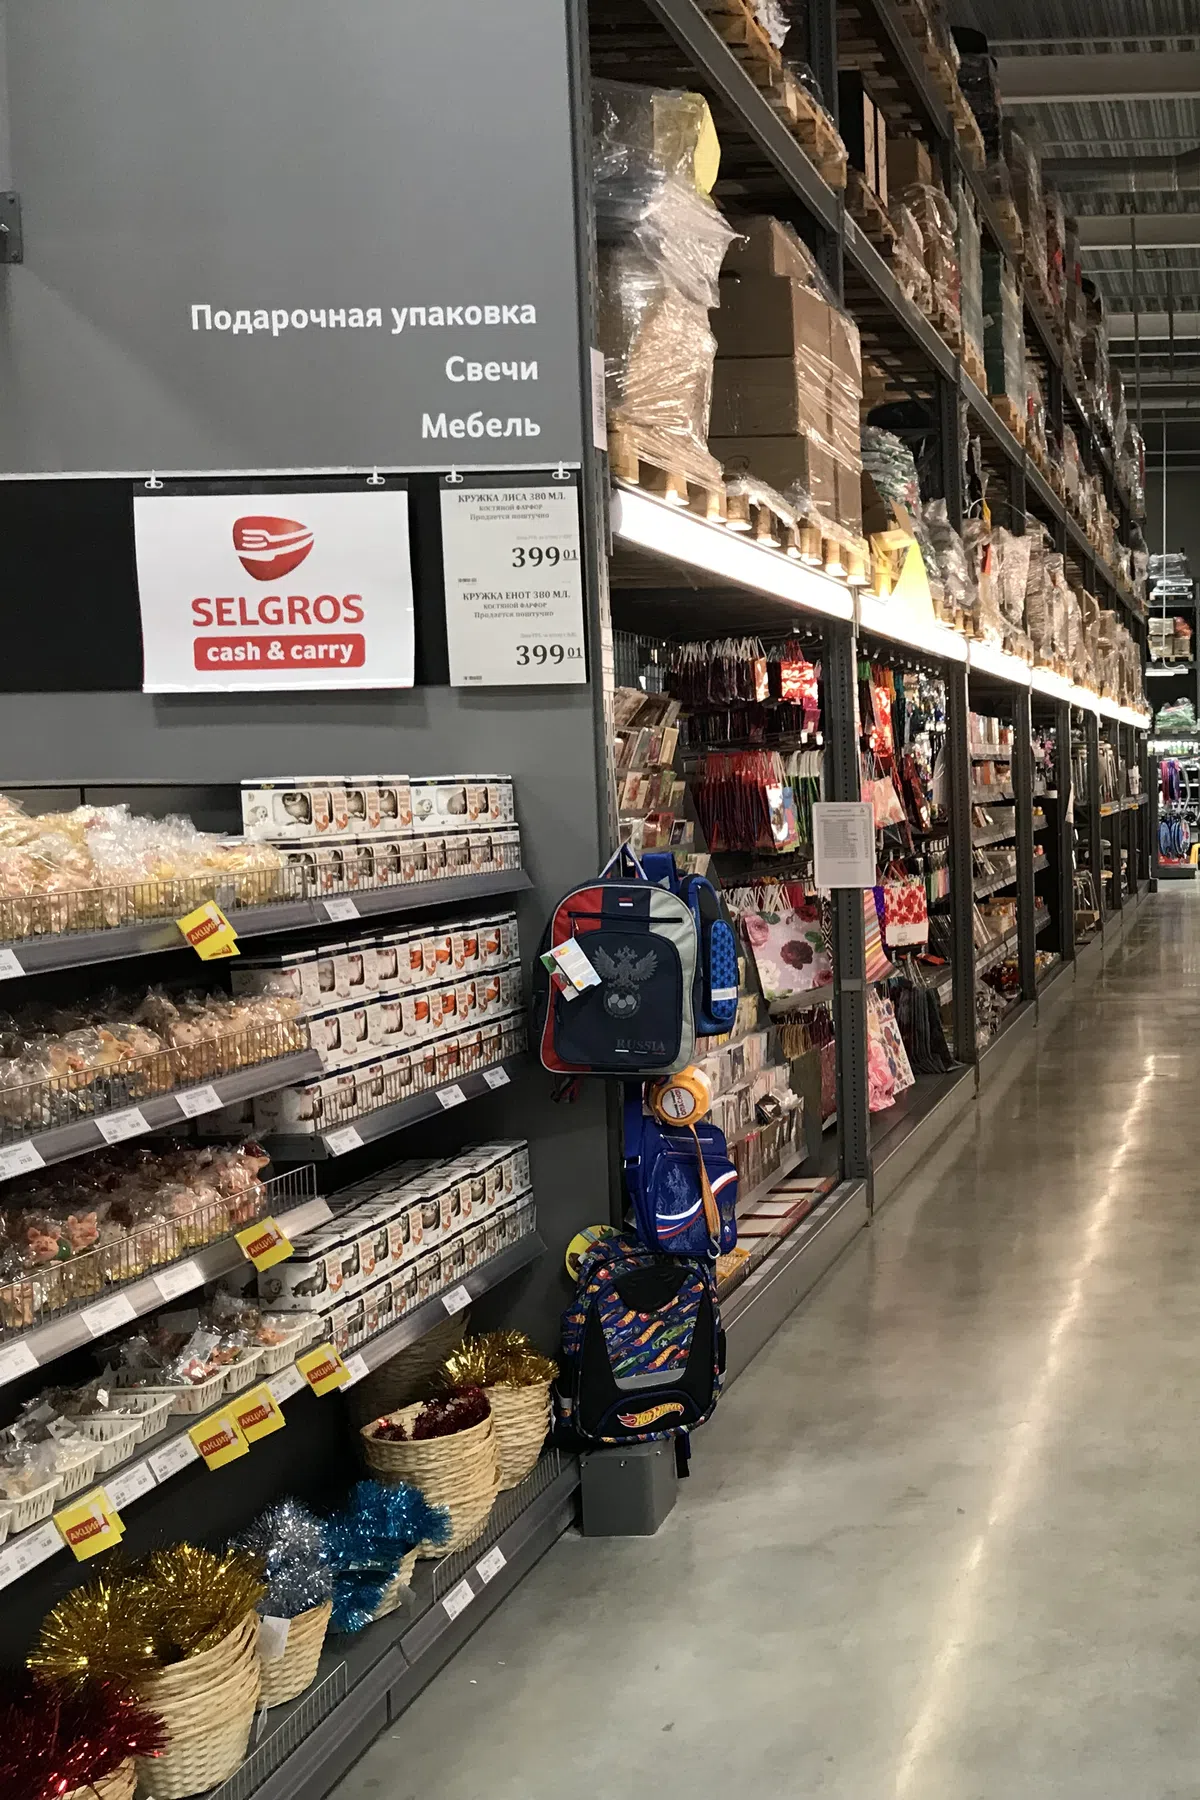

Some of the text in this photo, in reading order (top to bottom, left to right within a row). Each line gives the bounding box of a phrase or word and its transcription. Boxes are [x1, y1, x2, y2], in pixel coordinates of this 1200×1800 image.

[191, 303, 537, 336] Подарочная упаковка
[444, 356, 539, 383] Свечи
[421, 412, 541, 439] Мебель
[458, 494, 499, 503] КРУЖКА
[501, 493, 527, 502] ЛИСА
[530, 492, 546, 500] 380
[512, 546, 578, 568] 399 01
[463, 592, 503, 601] КРУЖКА
[505, 591, 531, 599] ЕНОТ
[533, 591, 551, 599] 380
[191, 594, 364, 627] SELGROS
[207, 638, 354, 668] cash & carry
[516, 644, 583, 666] 399 01
[616, 1039, 666, 1051] RUSSIA
